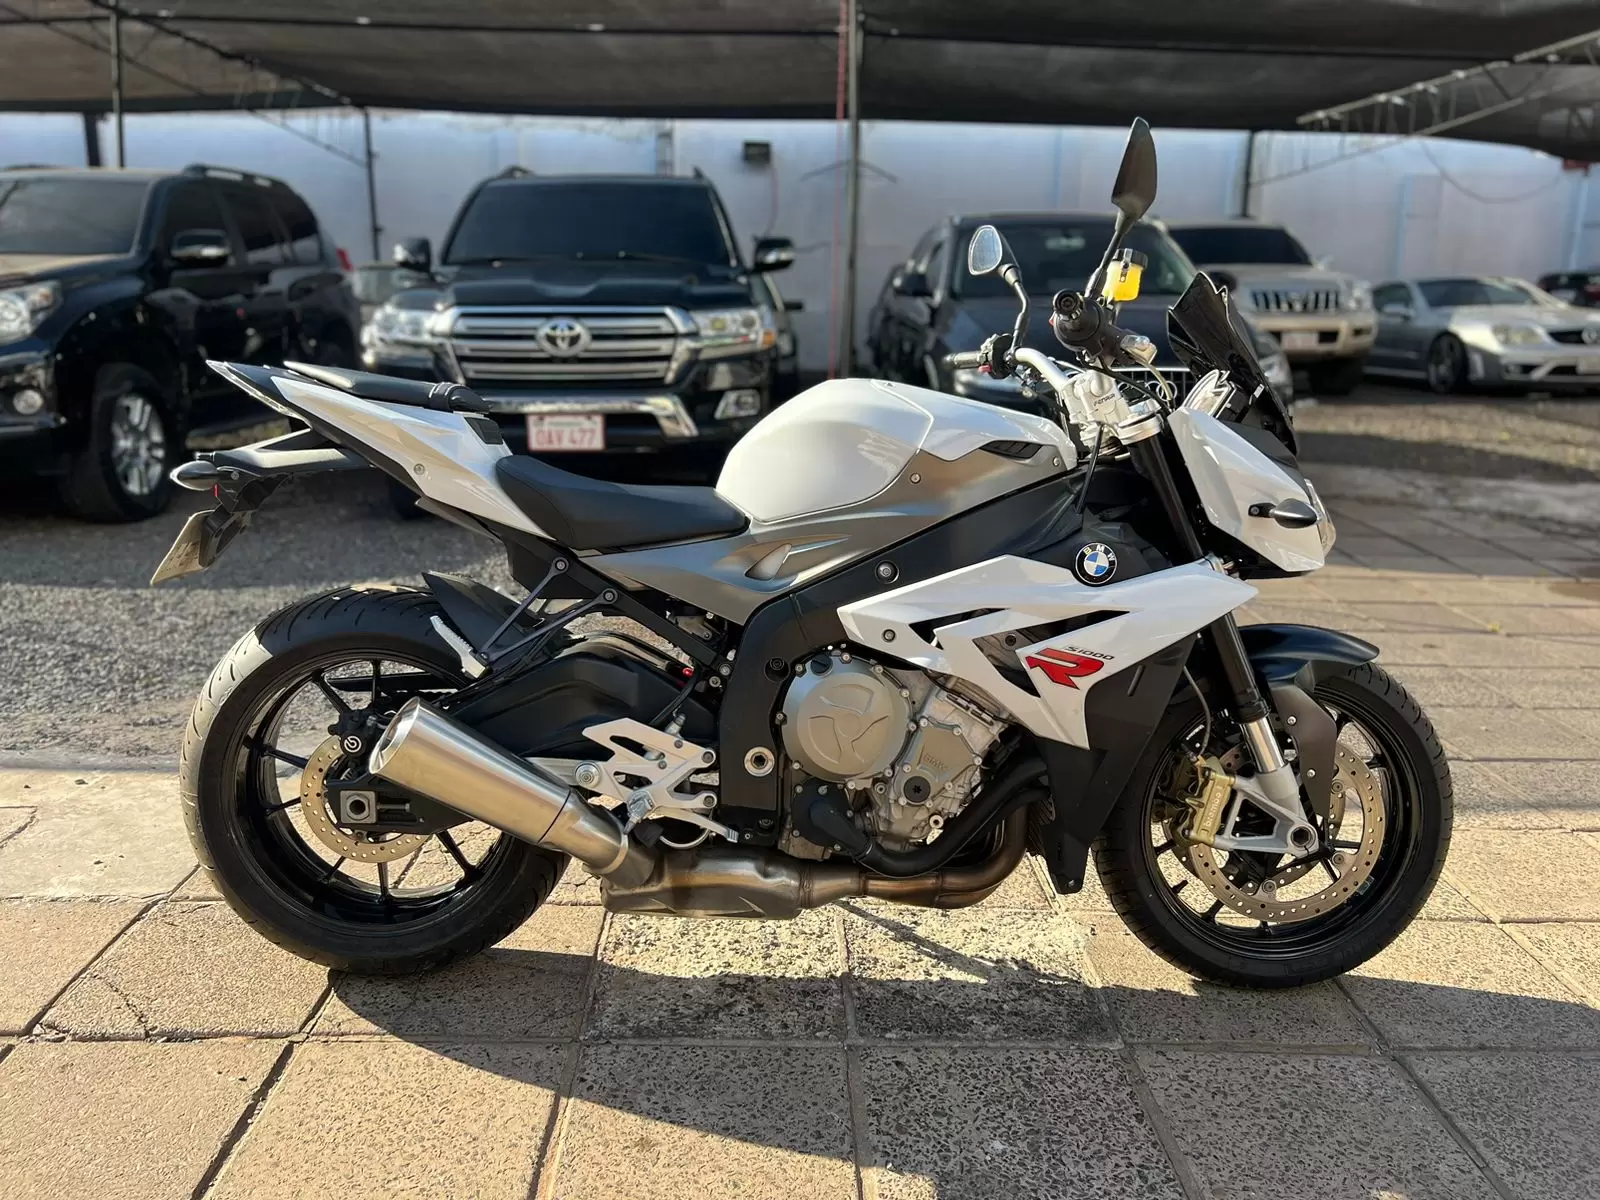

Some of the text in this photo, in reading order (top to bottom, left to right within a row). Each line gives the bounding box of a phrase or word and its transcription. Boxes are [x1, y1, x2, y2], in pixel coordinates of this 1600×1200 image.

[1083, 543, 1116, 562] BMW
[1064, 646, 1116, 661] S1000
[1025, 647, 1105, 690] R
[1203, 792, 1222, 828] brembo
